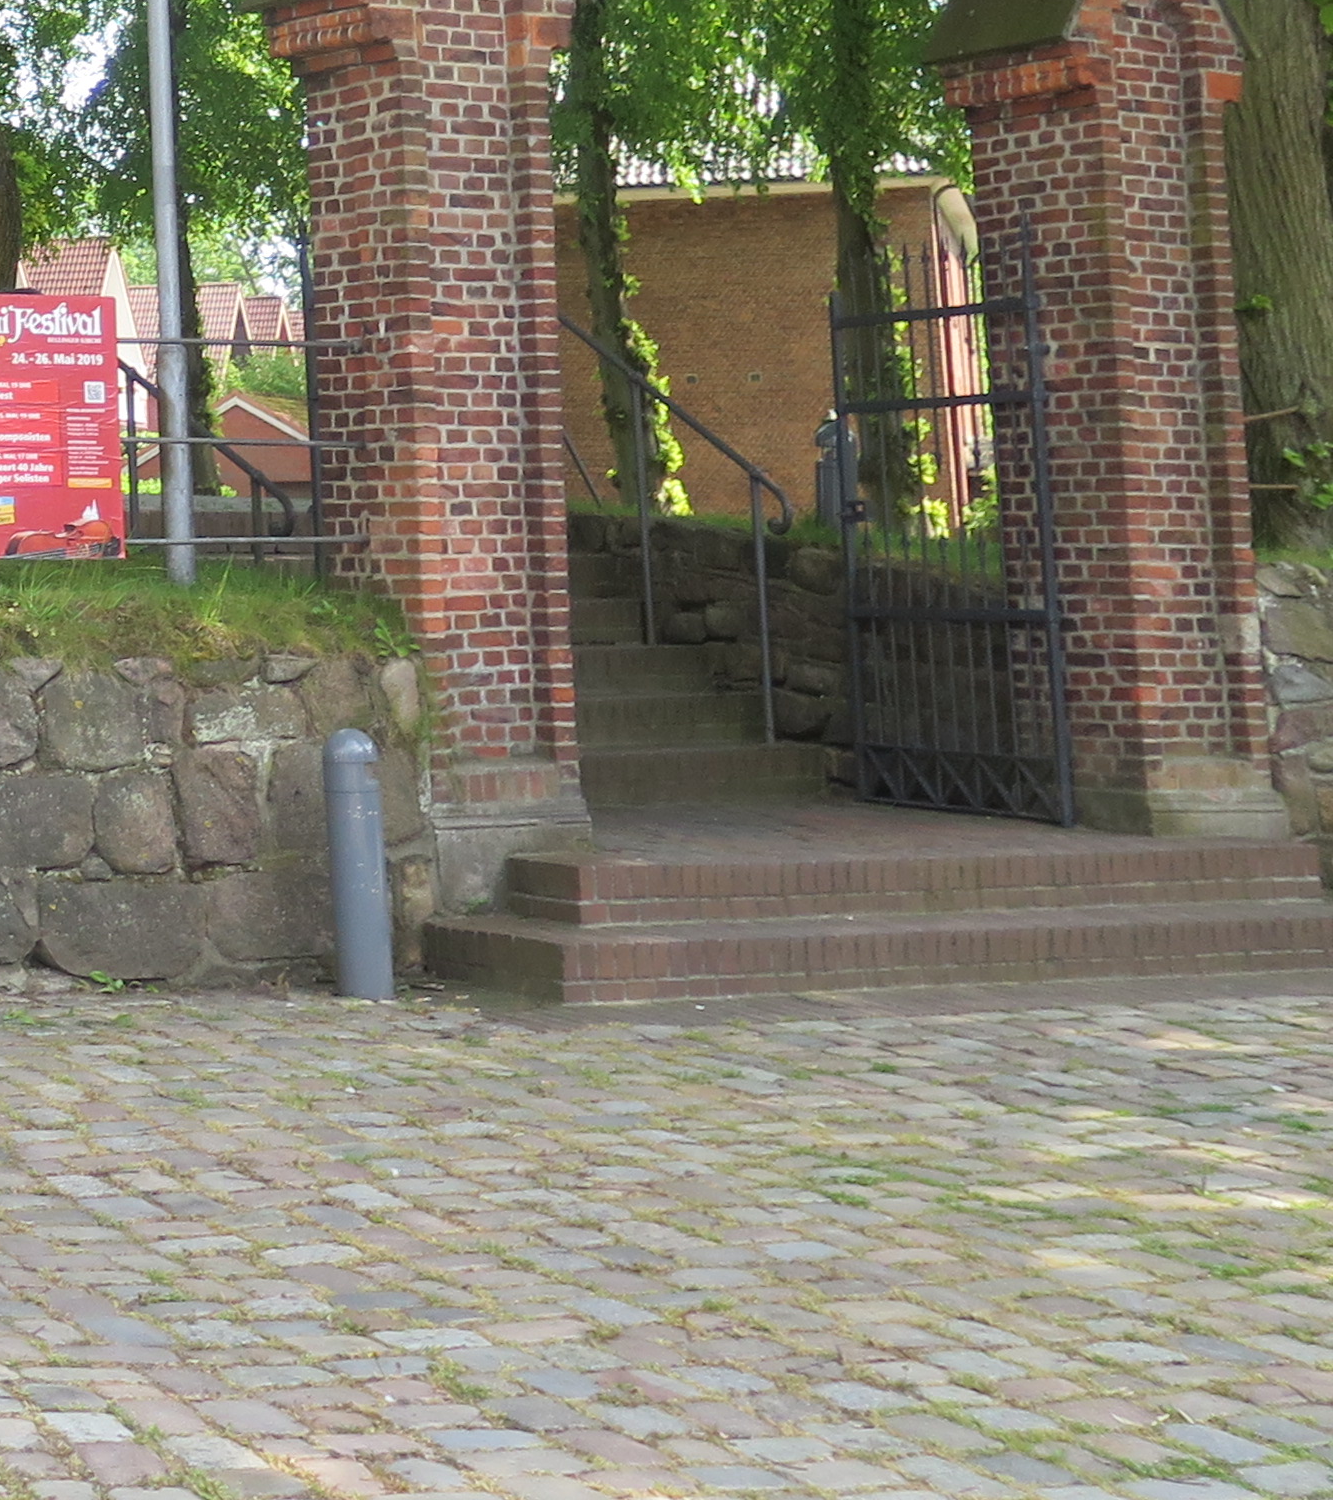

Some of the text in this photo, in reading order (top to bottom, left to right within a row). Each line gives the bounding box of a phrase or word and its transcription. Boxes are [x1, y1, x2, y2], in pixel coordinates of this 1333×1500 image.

[7, 302, 102, 343] Festival
[53, 353, 74, 365] Mai
[77, 353, 104, 366] 2019
[17, 463, 29, 472] 40
[30, 463, 54, 472] Jahre
[13, 473, 50, 483] Solisten
